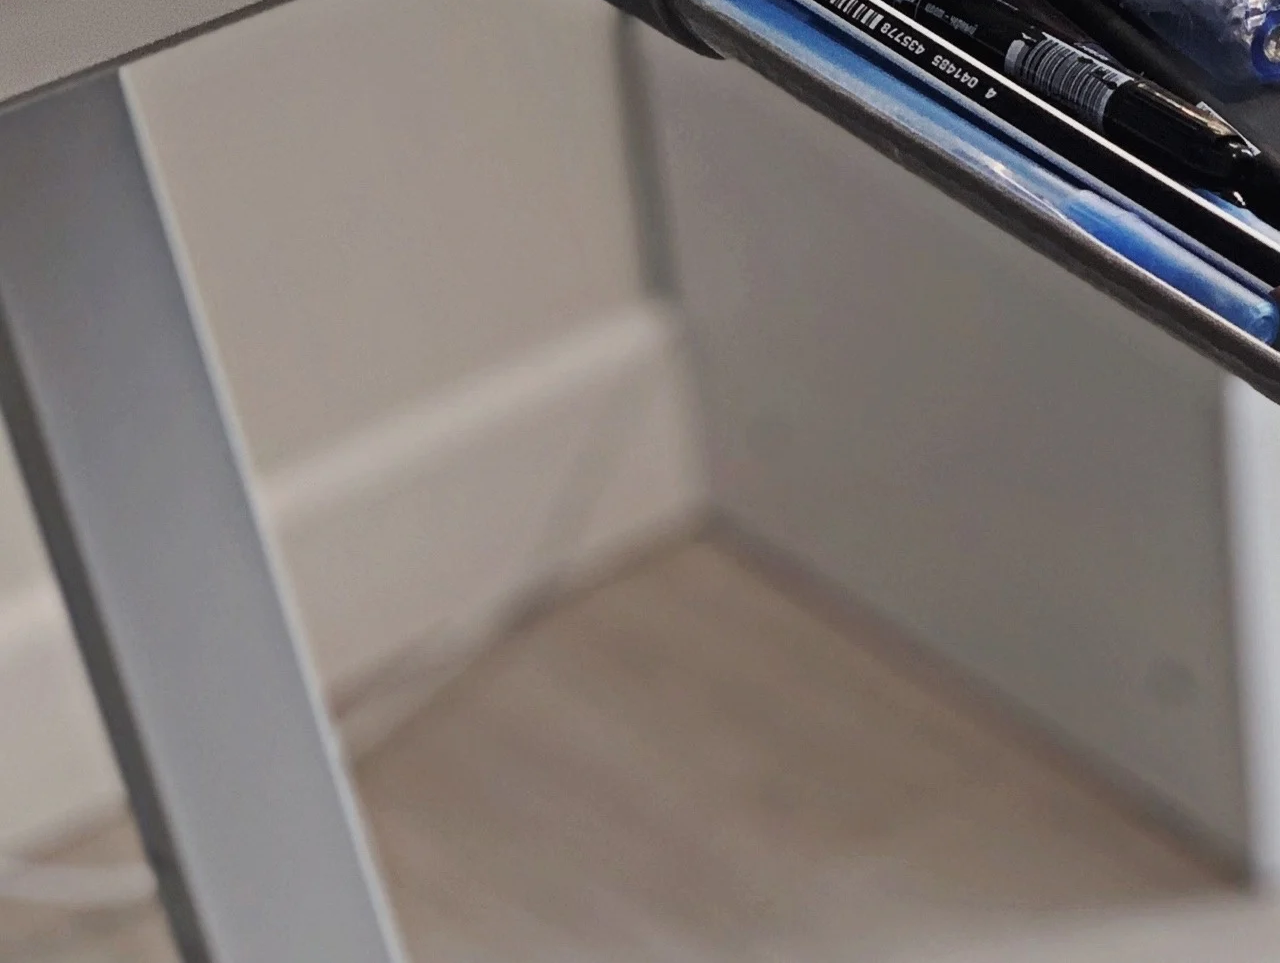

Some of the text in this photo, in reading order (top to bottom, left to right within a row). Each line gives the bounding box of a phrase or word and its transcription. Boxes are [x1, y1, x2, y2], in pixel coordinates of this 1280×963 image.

[880, 22, 997, 99] 4 041485 435778
